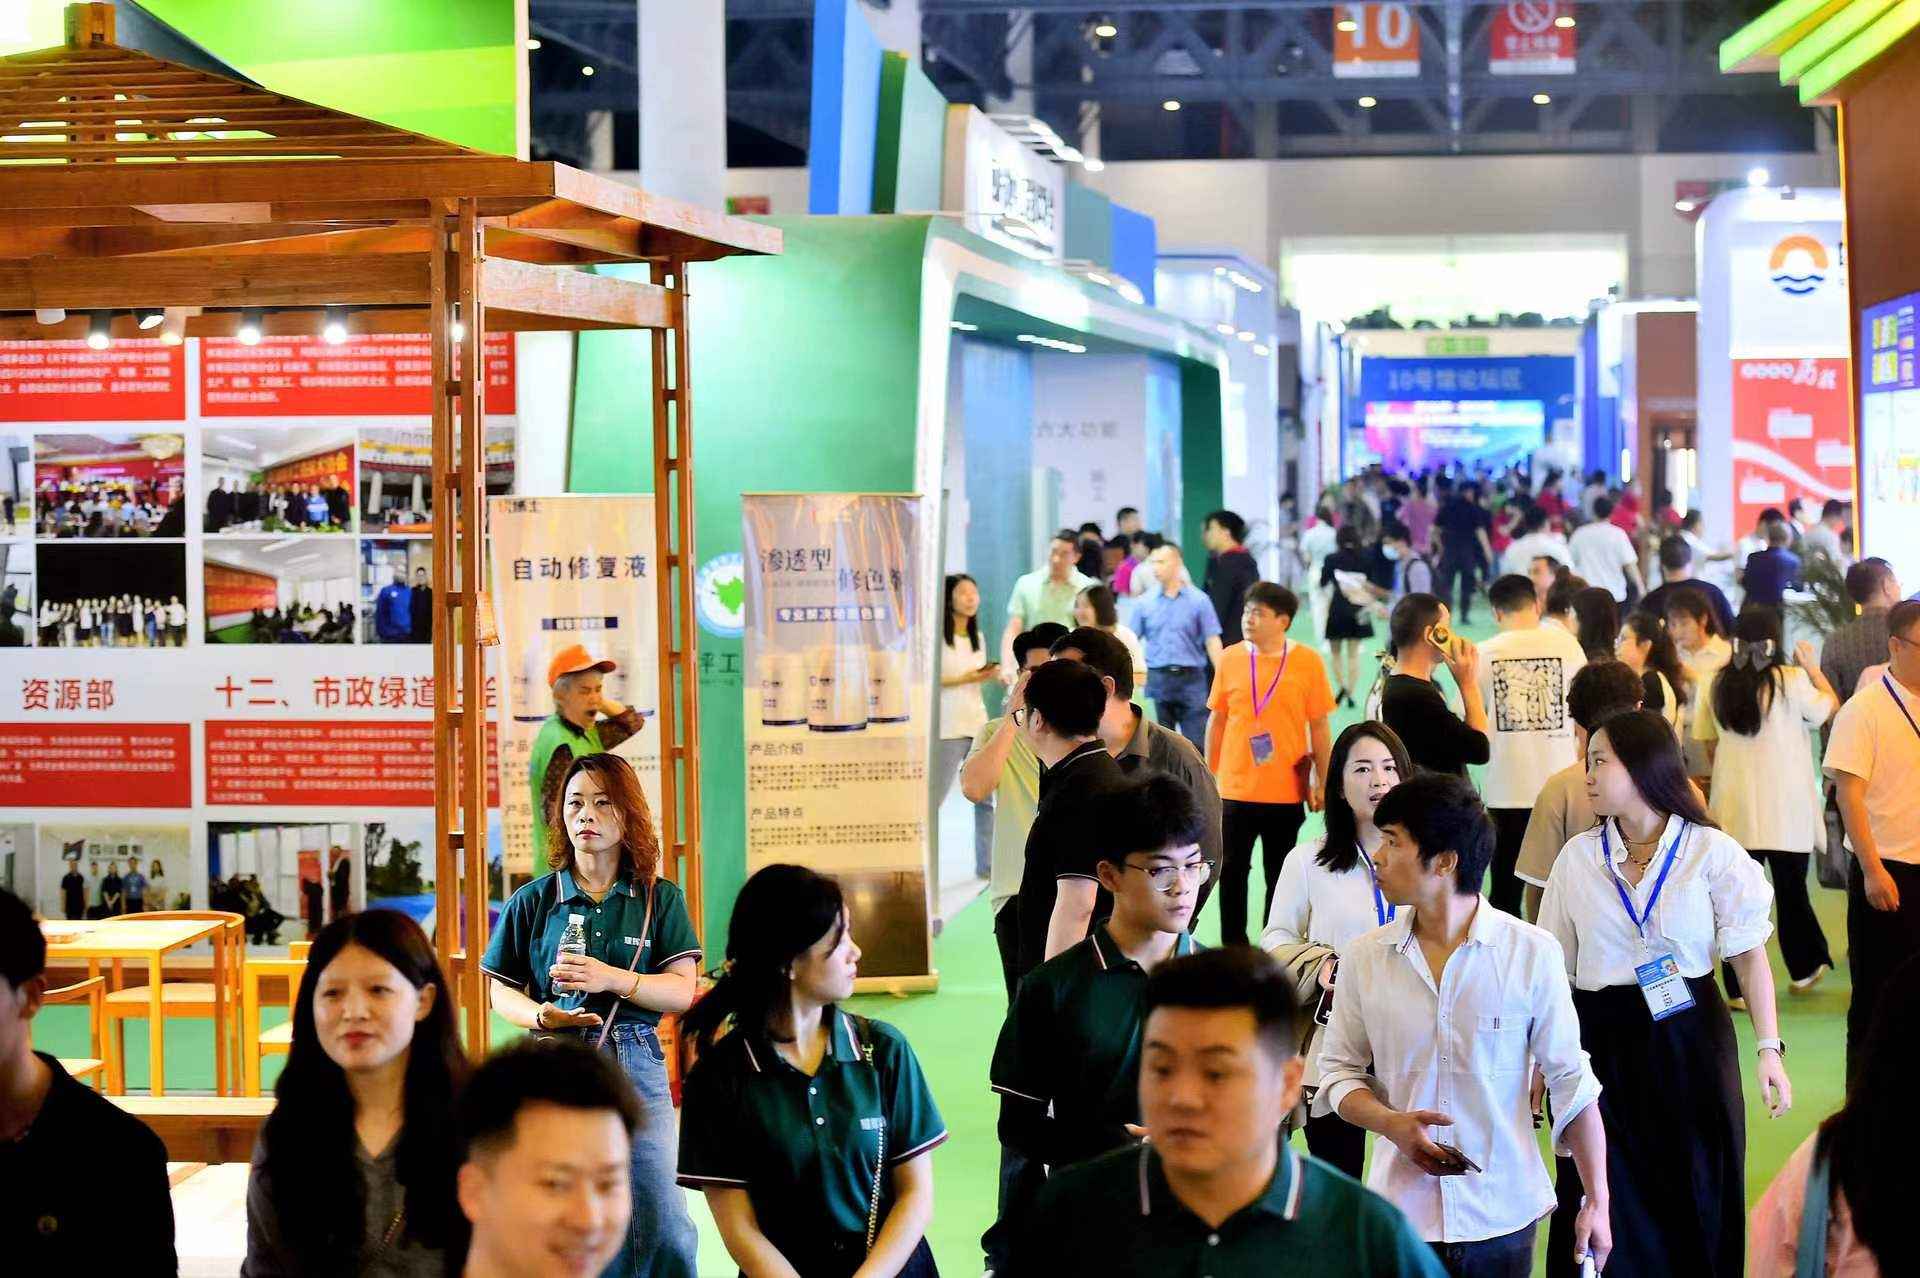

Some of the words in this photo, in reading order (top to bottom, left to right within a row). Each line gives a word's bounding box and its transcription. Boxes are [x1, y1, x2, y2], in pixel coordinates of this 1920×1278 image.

[513, 555, 647, 580] 自动修复液
[22, 678, 114, 710] 资源部
